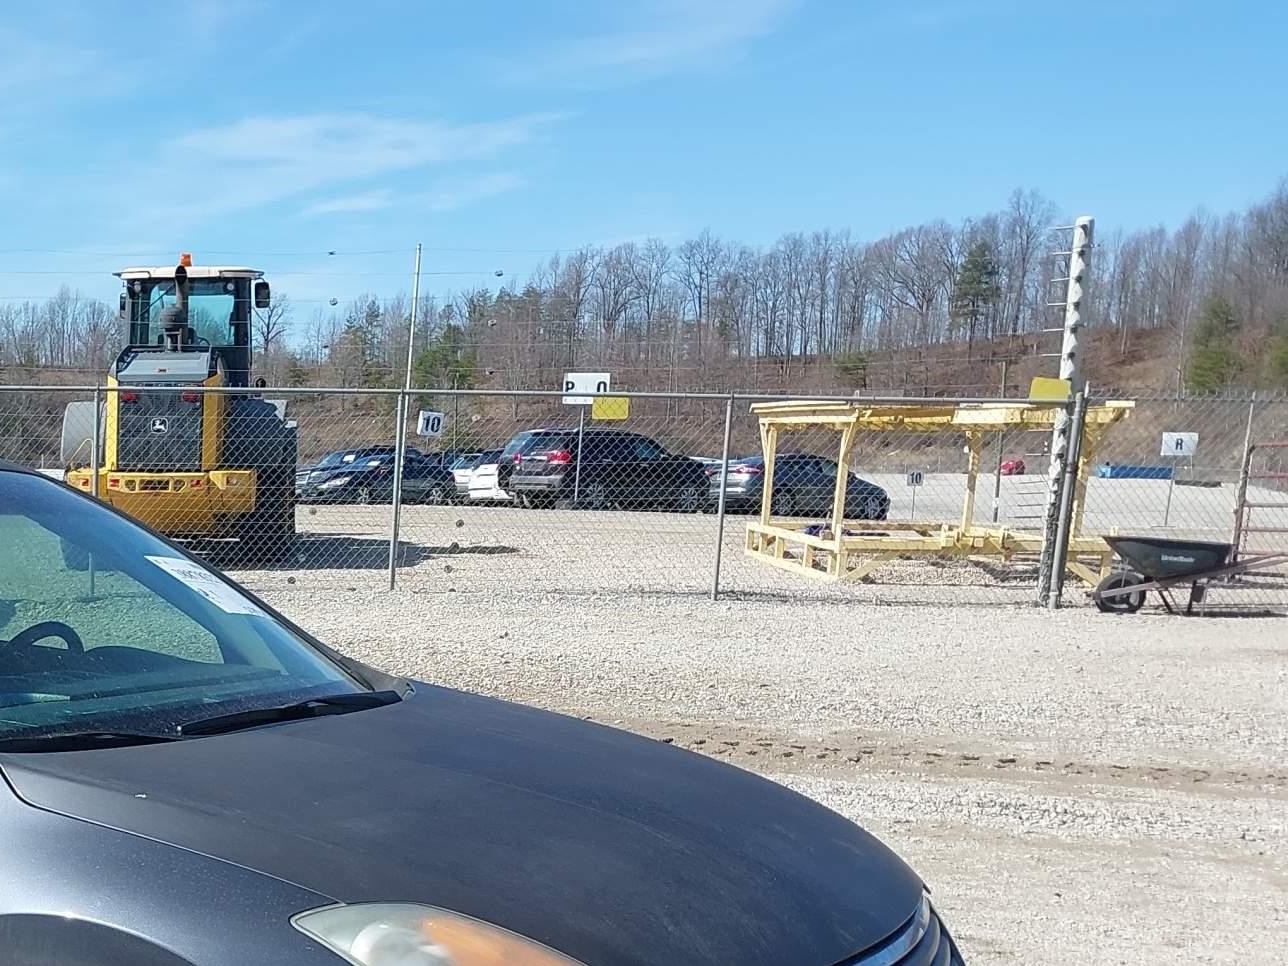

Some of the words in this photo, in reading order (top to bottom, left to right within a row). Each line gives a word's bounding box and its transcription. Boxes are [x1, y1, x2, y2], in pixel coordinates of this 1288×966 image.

[423, 415, 441, 433] 10
[1175, 437, 1184, 450] R
[909, 471, 922, 484] 10
